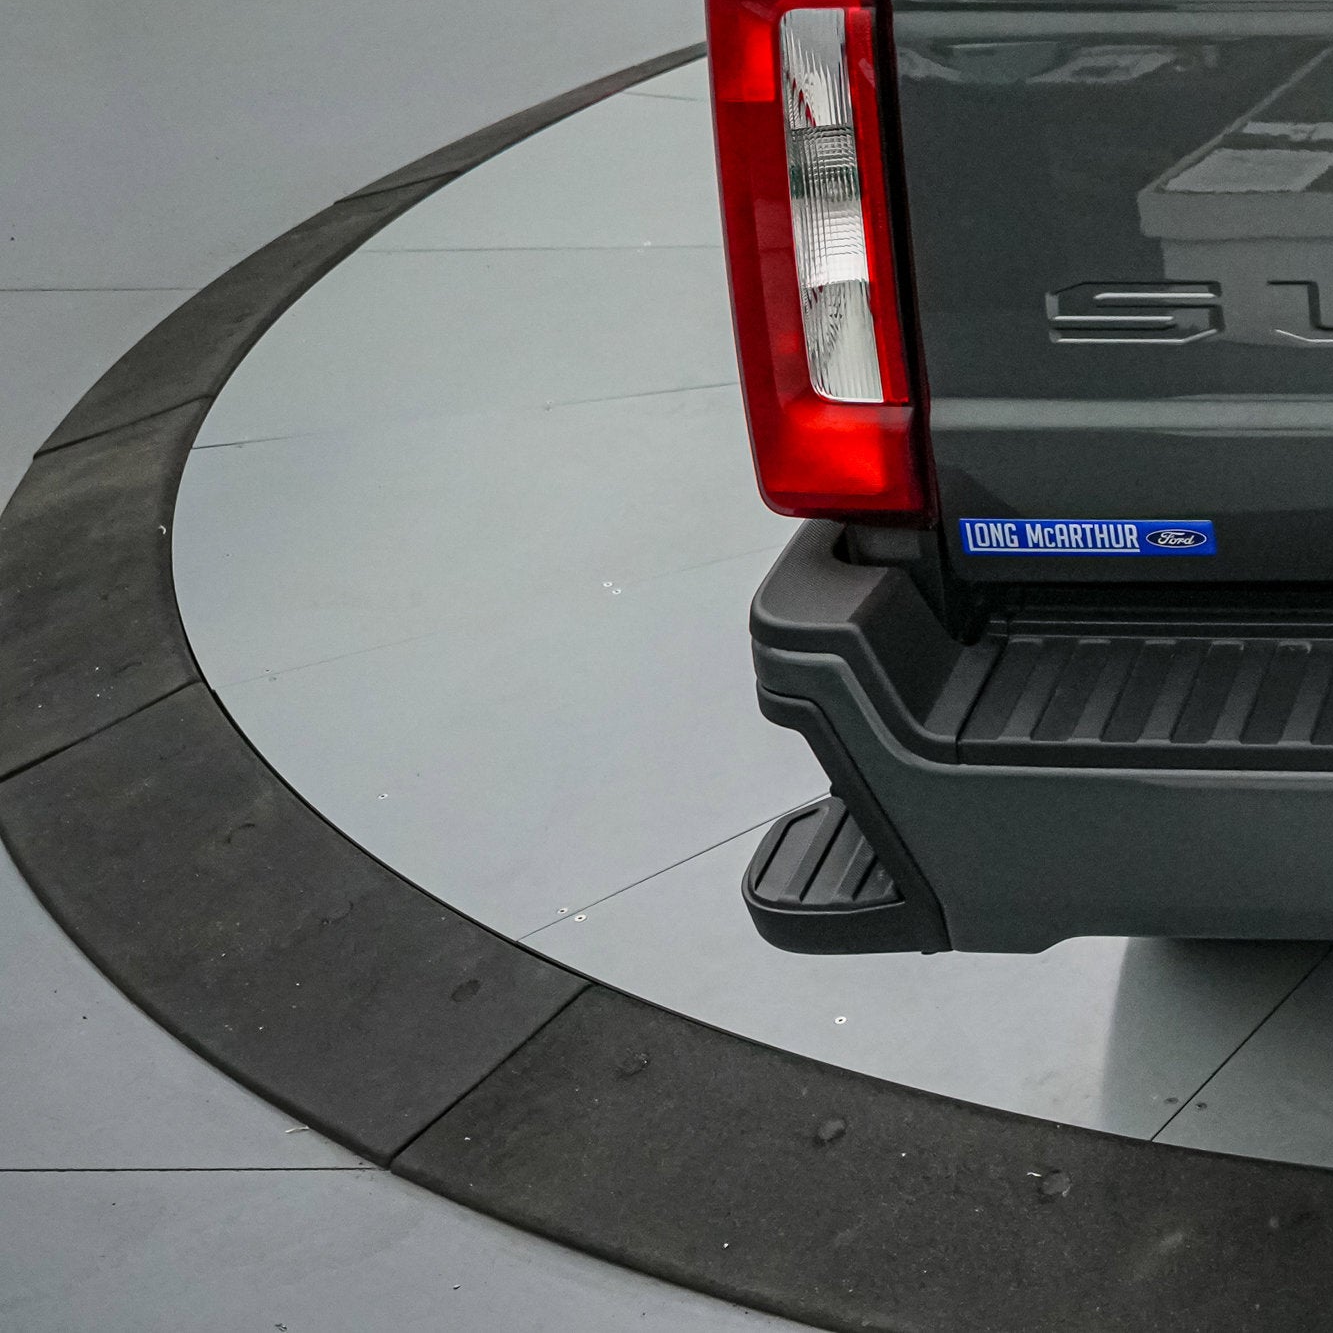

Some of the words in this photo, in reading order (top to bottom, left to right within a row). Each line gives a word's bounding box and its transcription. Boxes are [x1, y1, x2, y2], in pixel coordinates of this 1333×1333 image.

[965, 522, 1019, 552] LONG
[1025, 523, 1140, 549] McARTHUR
[1157, 529, 1195, 547] Ford
